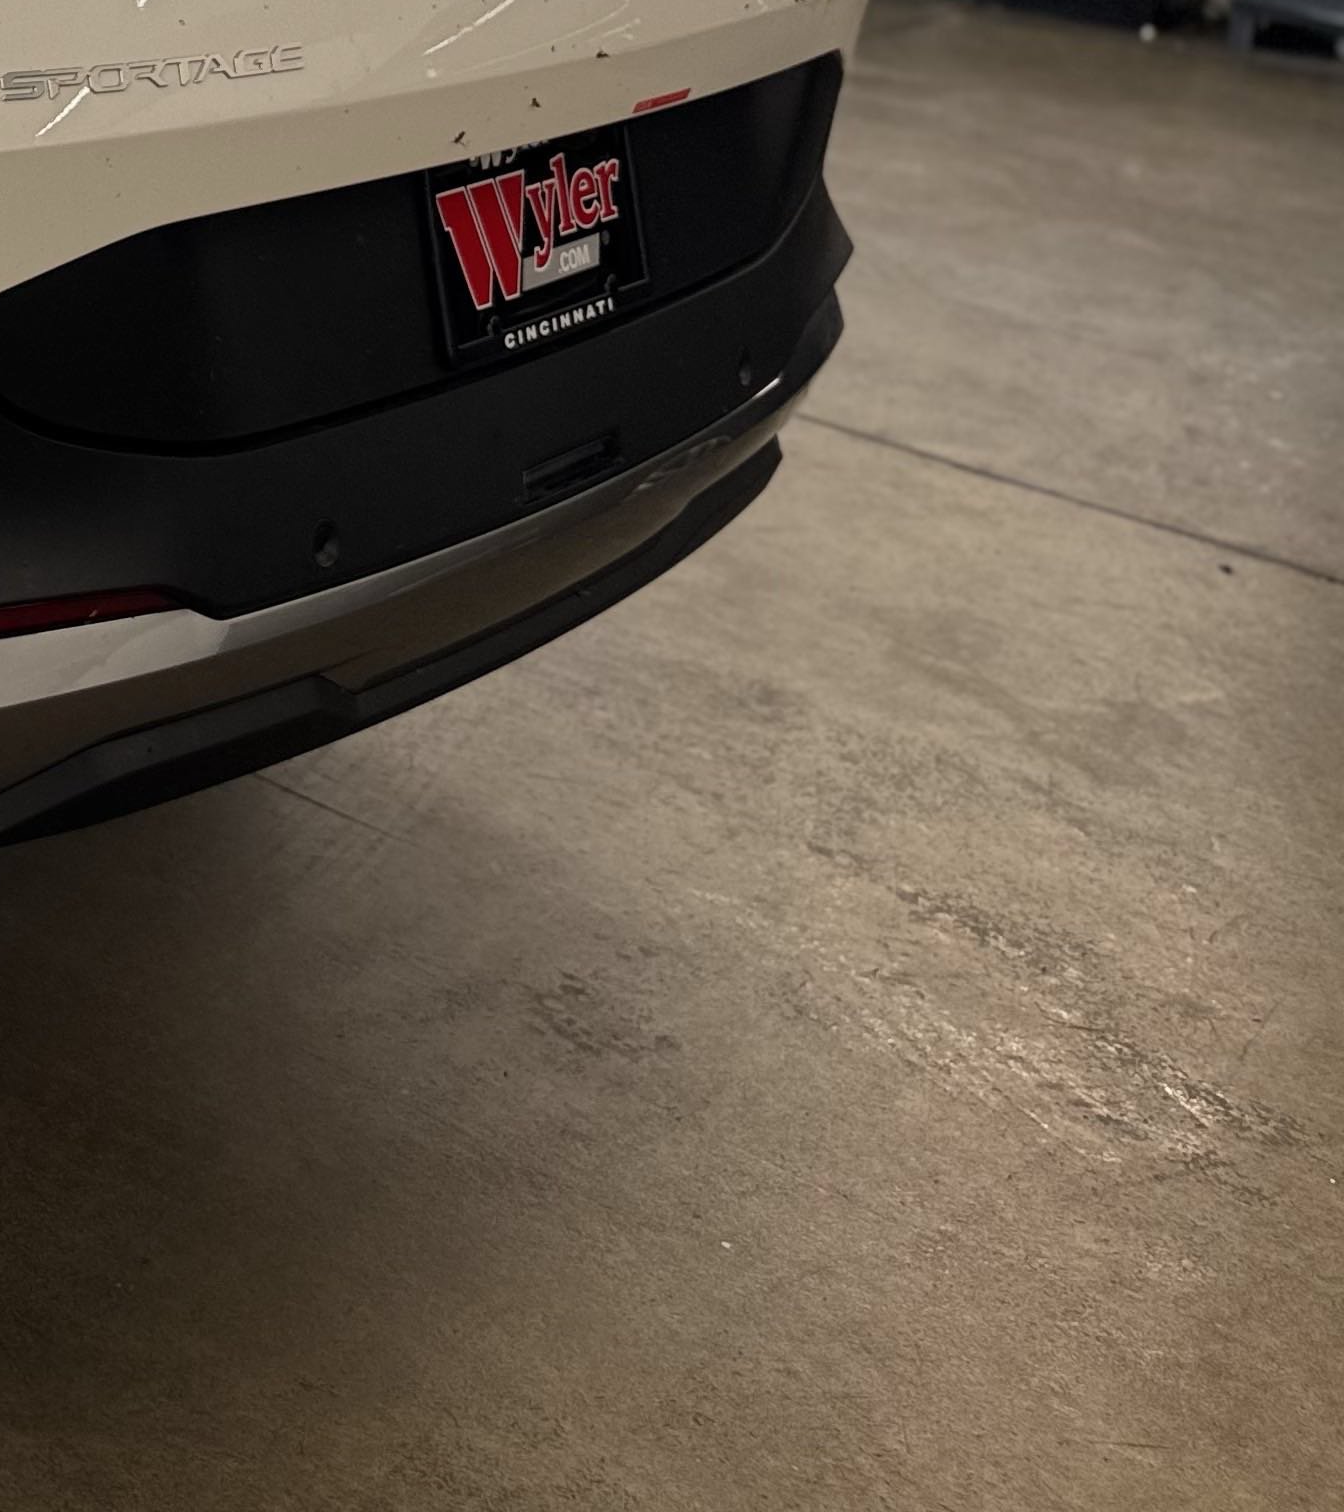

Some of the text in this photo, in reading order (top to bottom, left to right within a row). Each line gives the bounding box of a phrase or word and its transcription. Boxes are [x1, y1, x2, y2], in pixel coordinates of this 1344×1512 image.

[0, 43, 304, 101] SPORTAGE
[436, 153, 619, 311] Wyler
[504, 297, 614, 349] CINCINNATI
